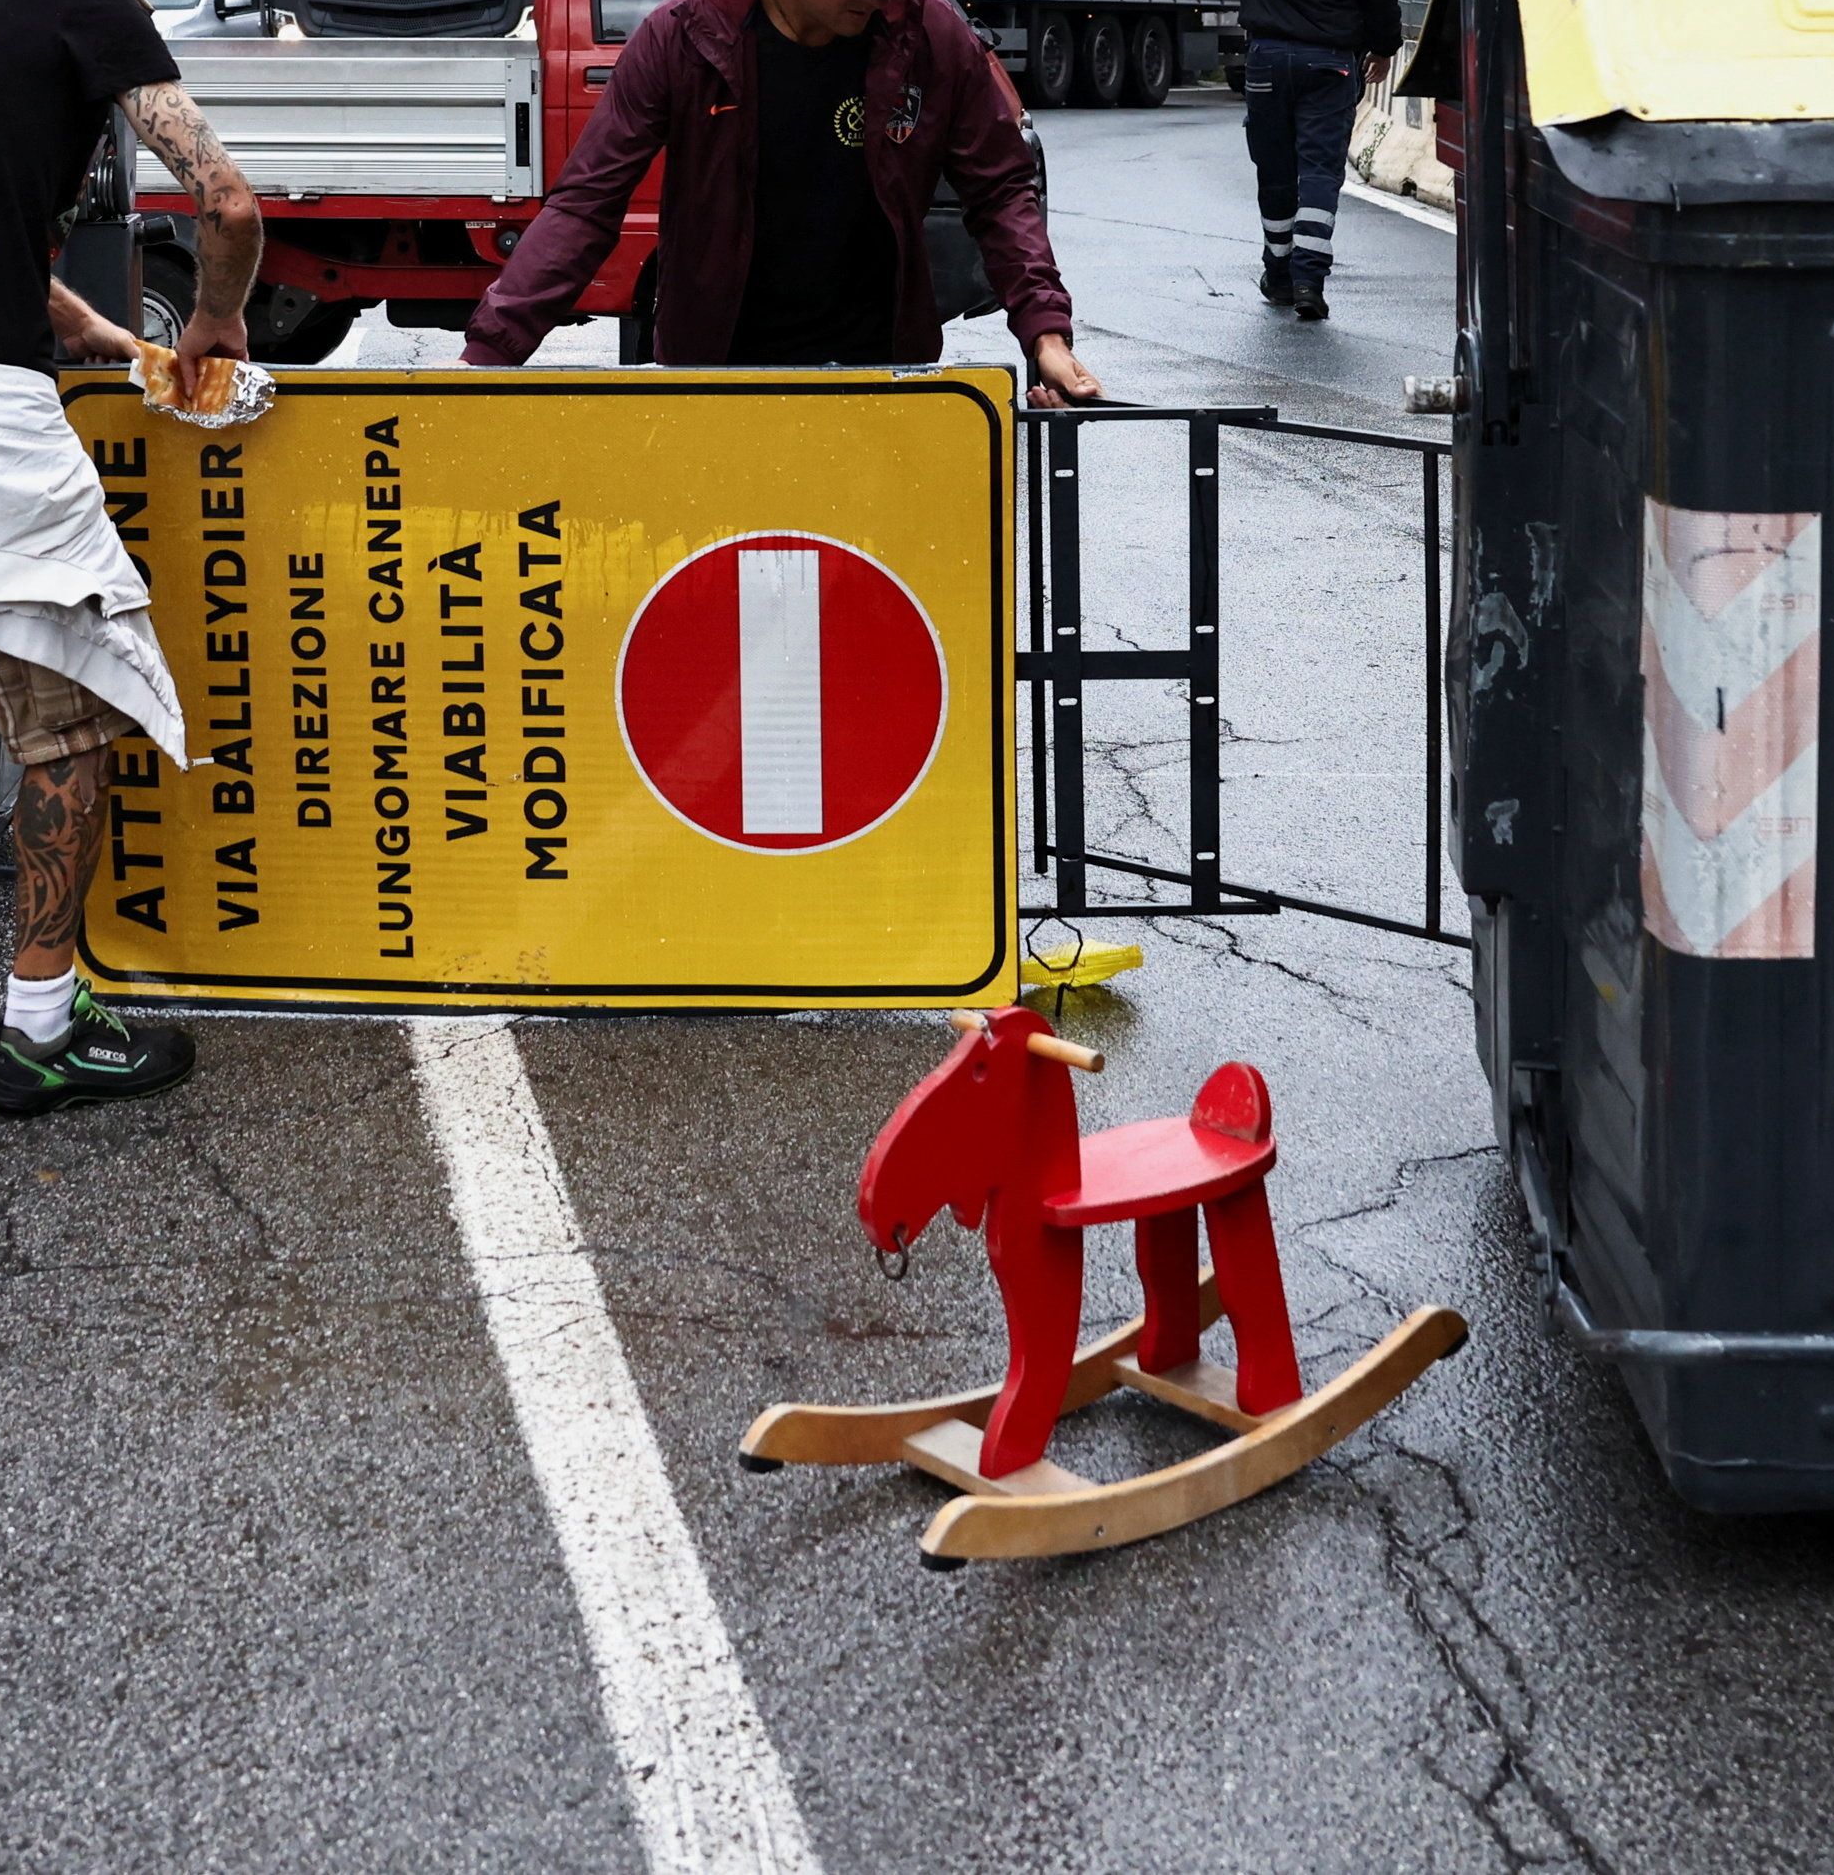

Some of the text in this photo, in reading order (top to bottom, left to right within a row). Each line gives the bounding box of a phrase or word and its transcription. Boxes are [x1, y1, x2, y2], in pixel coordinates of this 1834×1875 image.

[93, 436, 167, 933] ATTENE
[199, 443, 259, 932] VIA BALLEYDIER
[289, 553, 331, 828] DIREZIONE
[364, 416, 414, 958] LUNGOMARE CANEPA
[427, 541, 488, 842] VIABILITÀ
[517, 499, 569, 880] MODIFICATA
[89, 1046, 127, 1063] sparco
